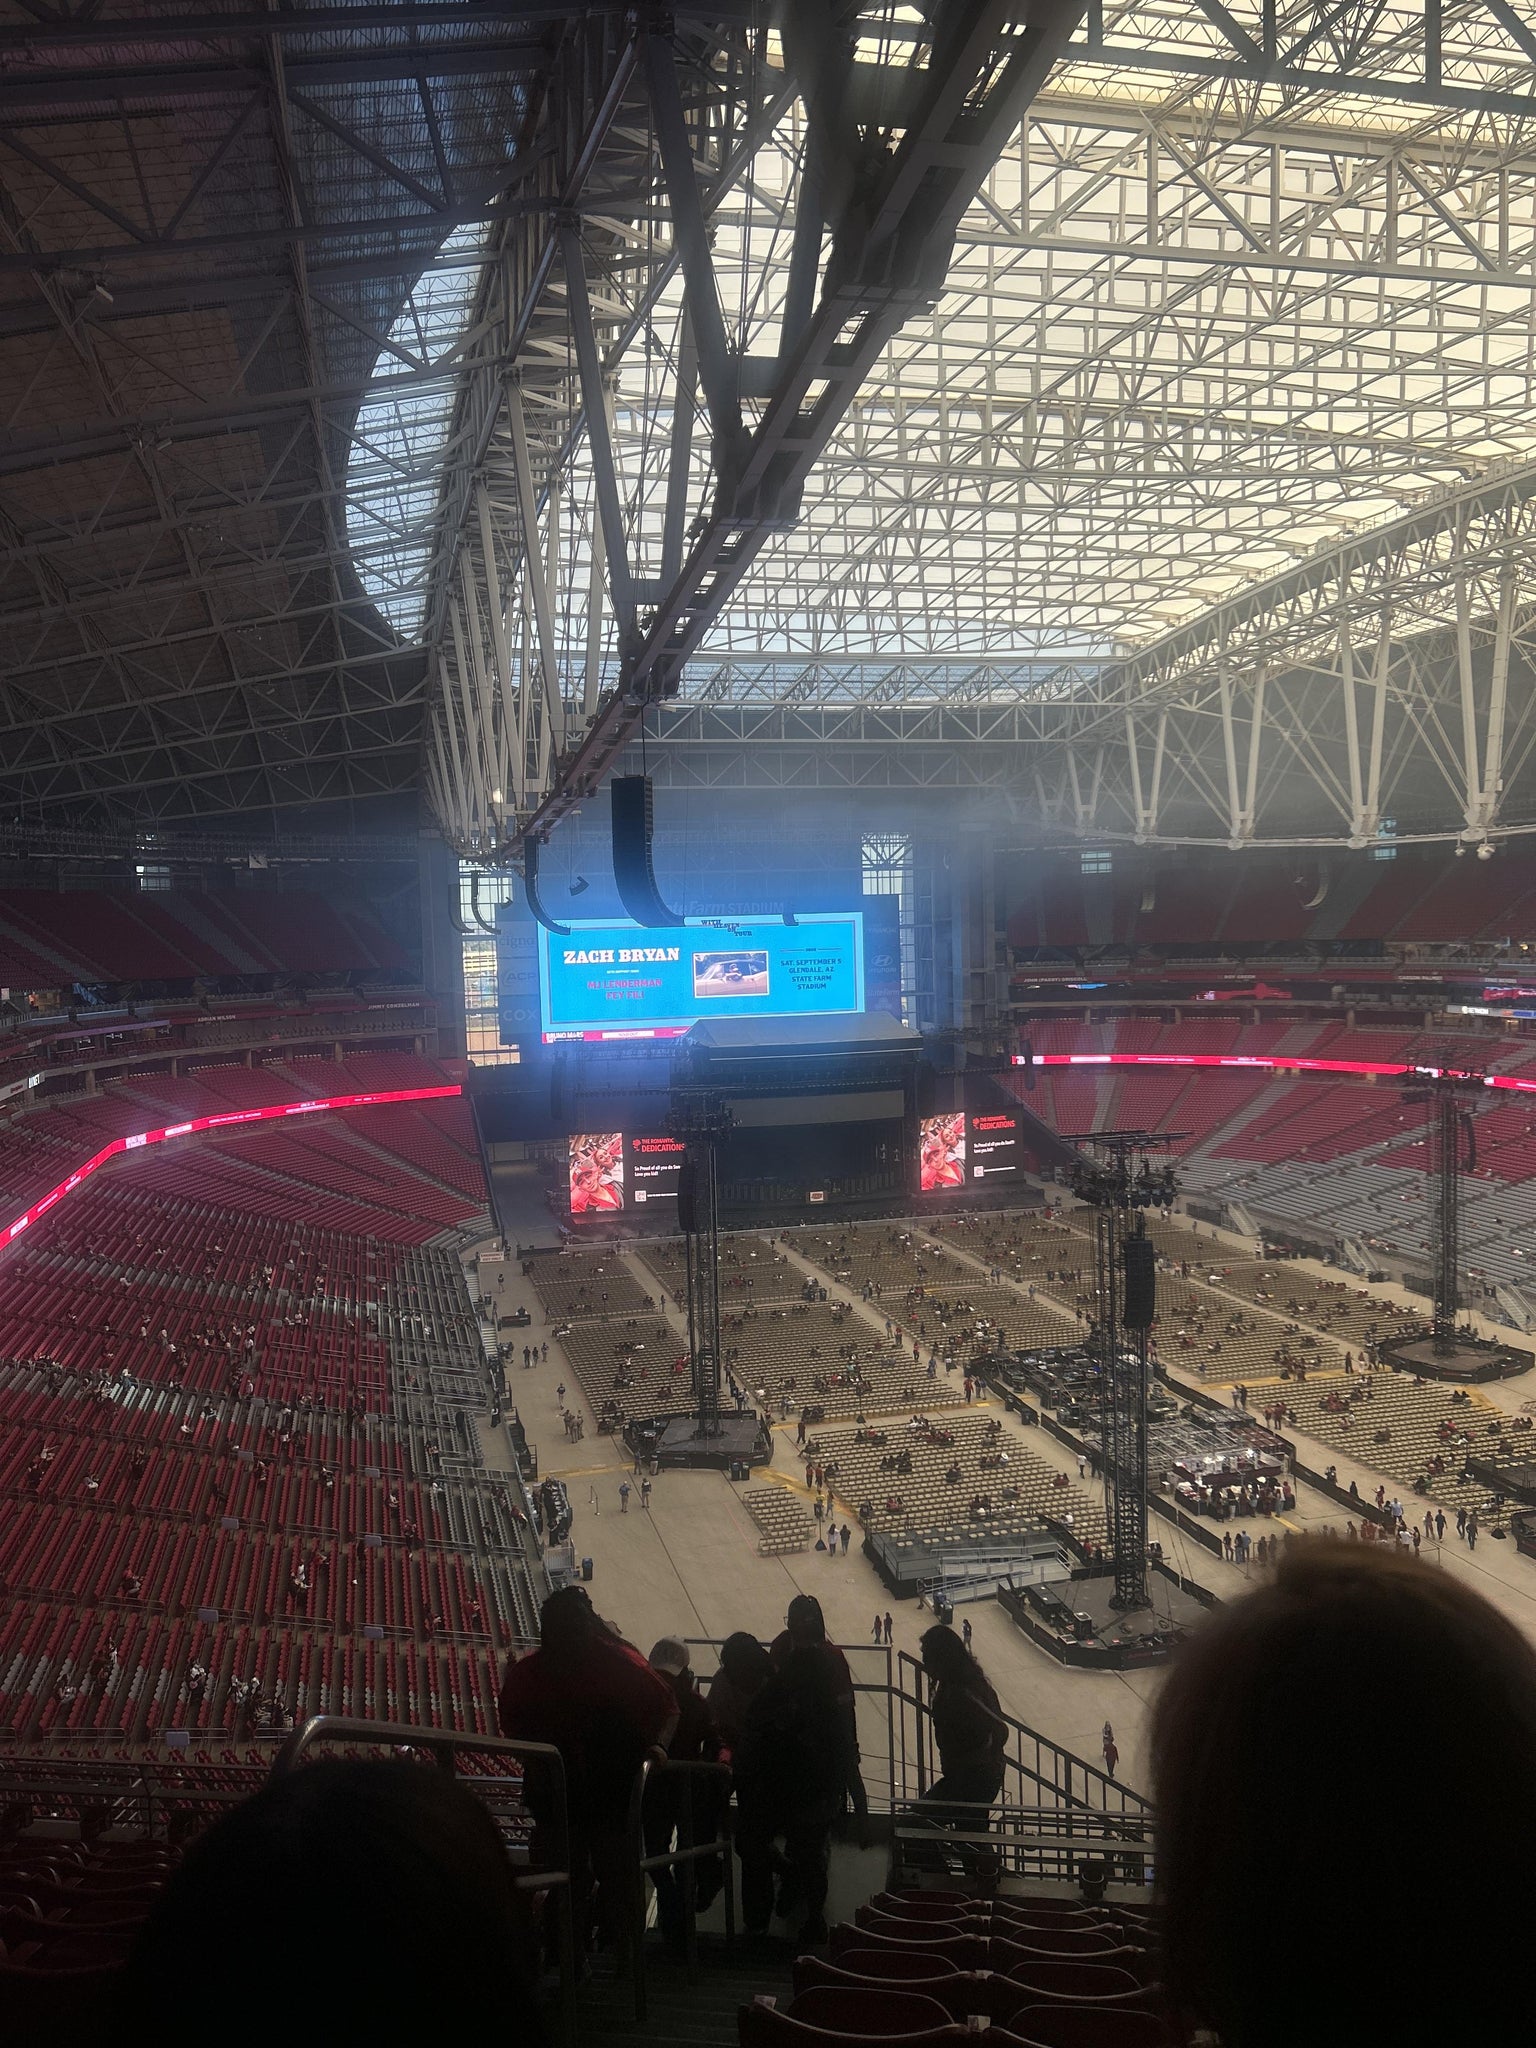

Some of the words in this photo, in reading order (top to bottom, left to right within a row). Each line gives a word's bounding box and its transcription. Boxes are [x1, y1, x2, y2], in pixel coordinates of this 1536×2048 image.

[688, 901, 725, 915] Farm
[728, 902, 784, 914] STADIUM
[563, 950, 614, 964] ZACH
[618, 948, 680, 963] BRYAN
[796, 958, 836, 966] SEPTEMBER
[603, 978, 662, 989] LENDERMAN
[606, 991, 624, 1000] FEY
[503, 1009, 537, 1021] COX
[642, 1143, 685, 1152] DEDICATIONS
